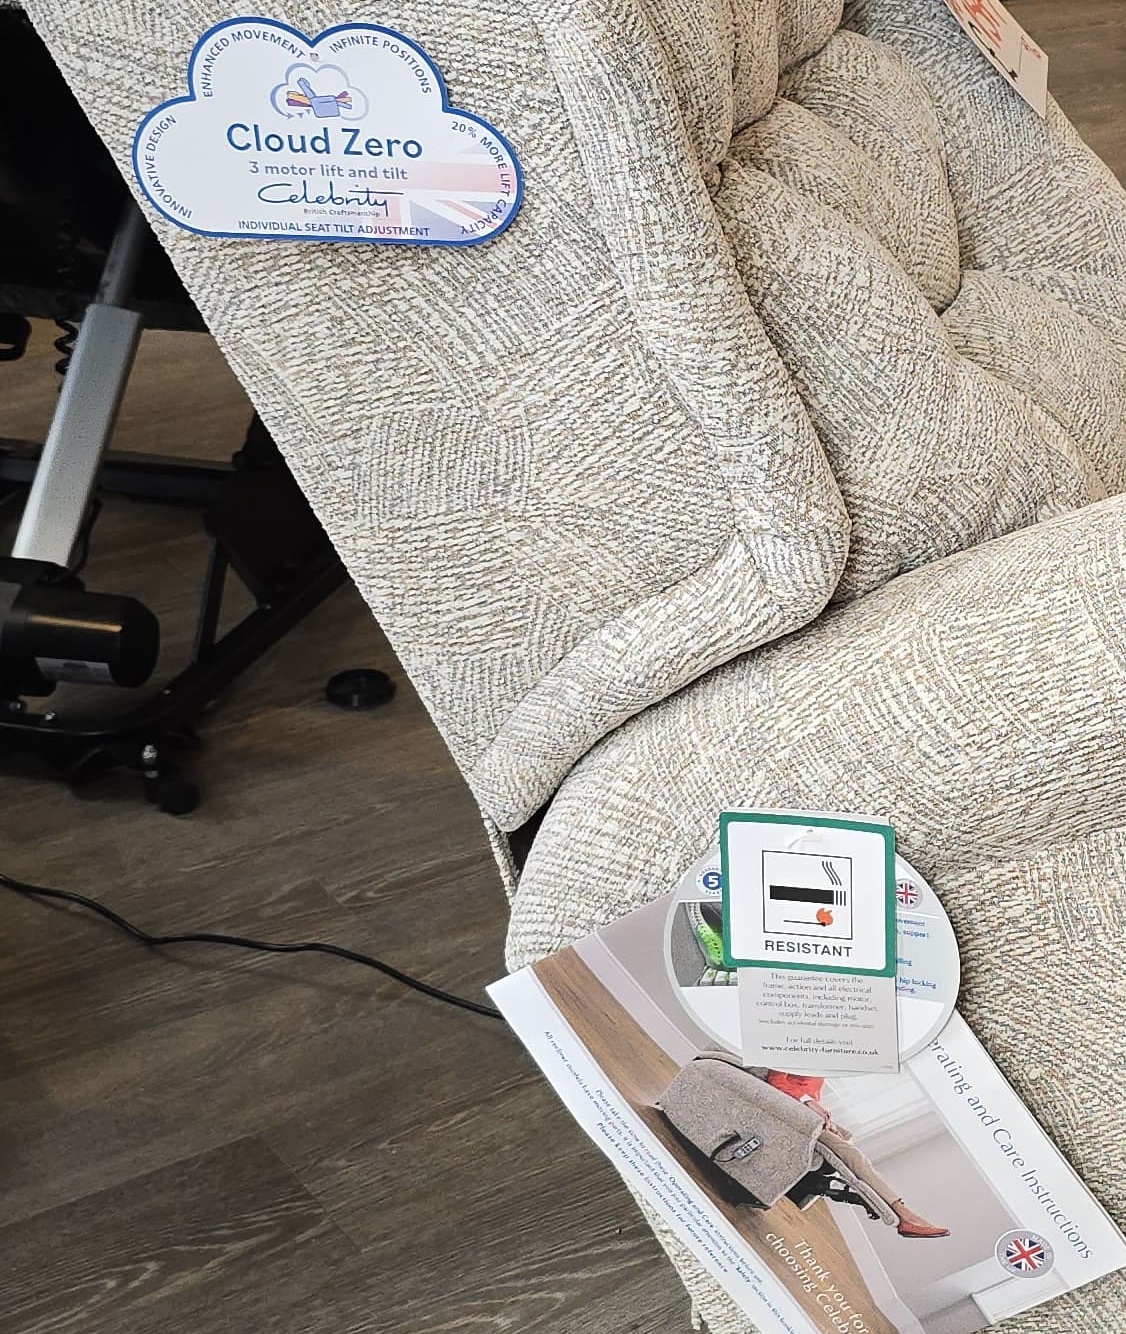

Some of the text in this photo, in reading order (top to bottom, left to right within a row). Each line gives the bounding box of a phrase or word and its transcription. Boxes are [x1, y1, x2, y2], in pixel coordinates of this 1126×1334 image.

[201, 29, 306, 97] ENHANCED MOVEMENT
[329, 34, 432, 94] INFINITE POSITIONS
[226, 123, 423, 159] Cloud Zero
[144, 114, 192, 219] INNOVATIVE DESIGN
[249, 161, 408, 180] 3 motor lift and tilt
[451, 121, 511, 235] 20% MORE LIFT CAPACITY
[257, 179, 404, 217] Celebrity
[238, 220, 430, 237] INDIVIDUAL SEAT TILT ADJUSTMENT
[708, 875, 718, 887] 5
[764, 940, 853, 959] RESISTANT
[788, 983, 811, 991] action
[828, 984, 837, 992] all
[838, 985, 872, 994] electrical
[812, 994, 846, 1002] including
[779, 1011, 802, 1019] supply
[761, 1046, 880, 1056] www.celebrity-furniture.co.uk
[786, 1035, 853, 1046] For full details visit
[967, 1094, 1001, 1127] and
[991, 1127, 1025, 1169] Care
[1021, 1170, 1095, 1260] Instructions
[595, 1120, 617, 1145] Please
[612, 1141, 631, 1161] keep
[627, 1157, 646, 1178] these
[642, 1173, 678, 1215] instructions
[683, 1221, 705, 1245] future
[700, 1240, 730, 1275] reference
[691, 1201, 705, 1216] and
[713, 1226, 742, 1260] instructions
[765, 1233, 817, 1293] choosing
[795, 1238, 869, 1334] Thank you for
